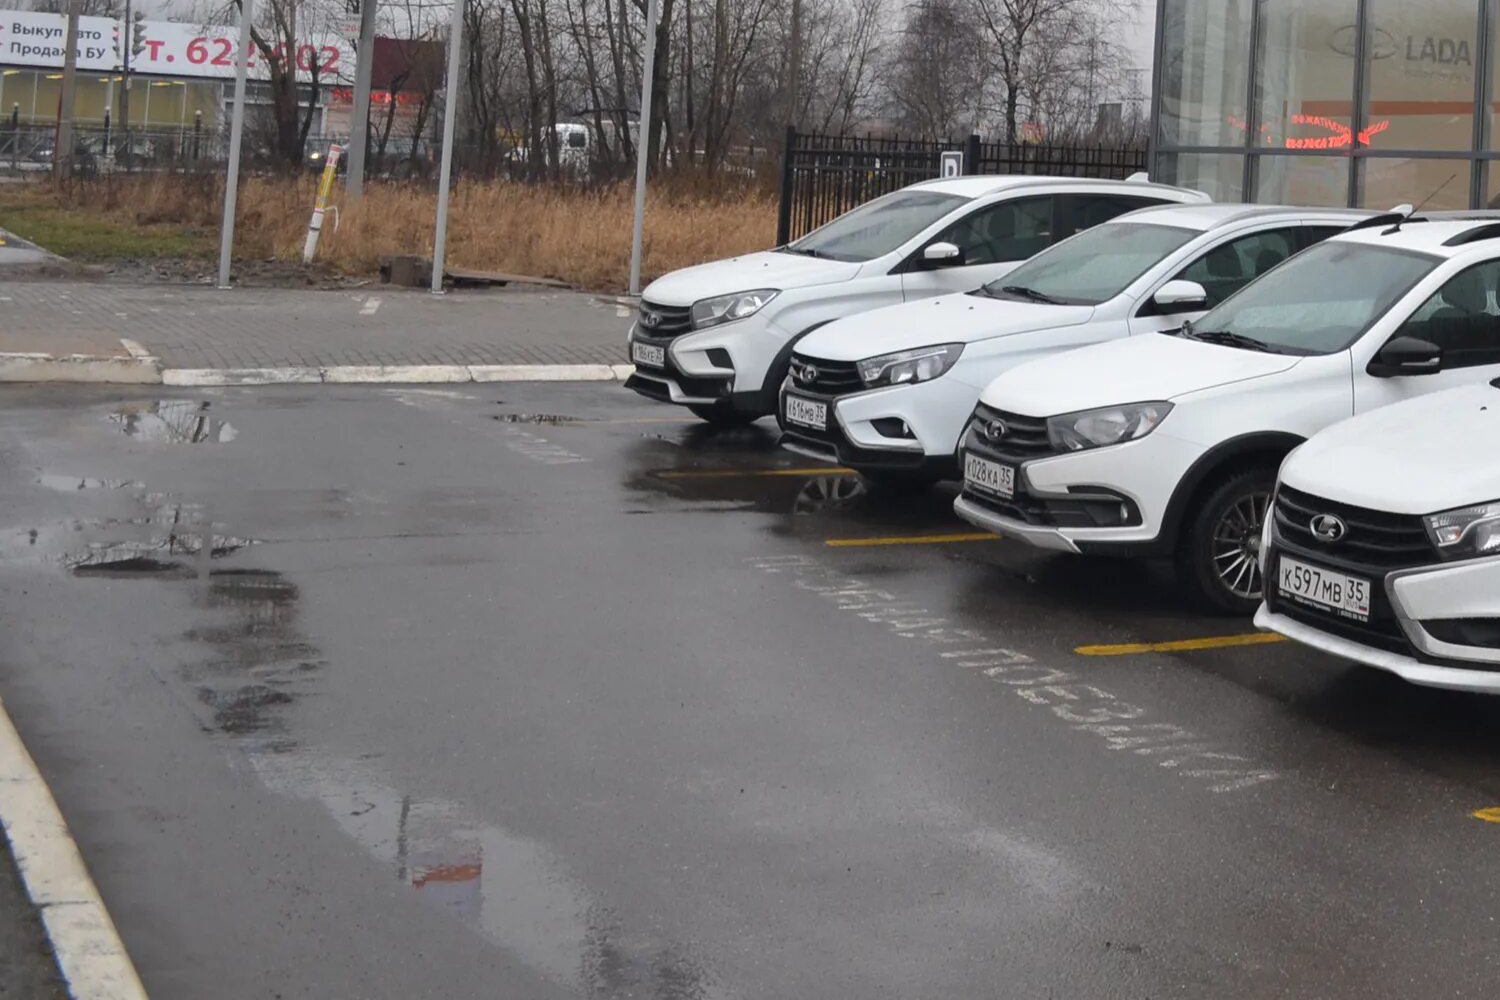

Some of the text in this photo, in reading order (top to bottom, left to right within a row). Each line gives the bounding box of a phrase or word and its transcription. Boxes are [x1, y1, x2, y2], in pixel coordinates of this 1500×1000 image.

[12, 22, 102, 40] Выкуп вто
[86, 46, 106, 59] БУ
[145, 39, 175, 63] т.
[1406, 35, 1471, 66] LADA
[967, 458, 1011, 487] К028КА 35
[1284, 565, 1342, 603] К597МВ
[1347, 580, 1364, 602] 35
